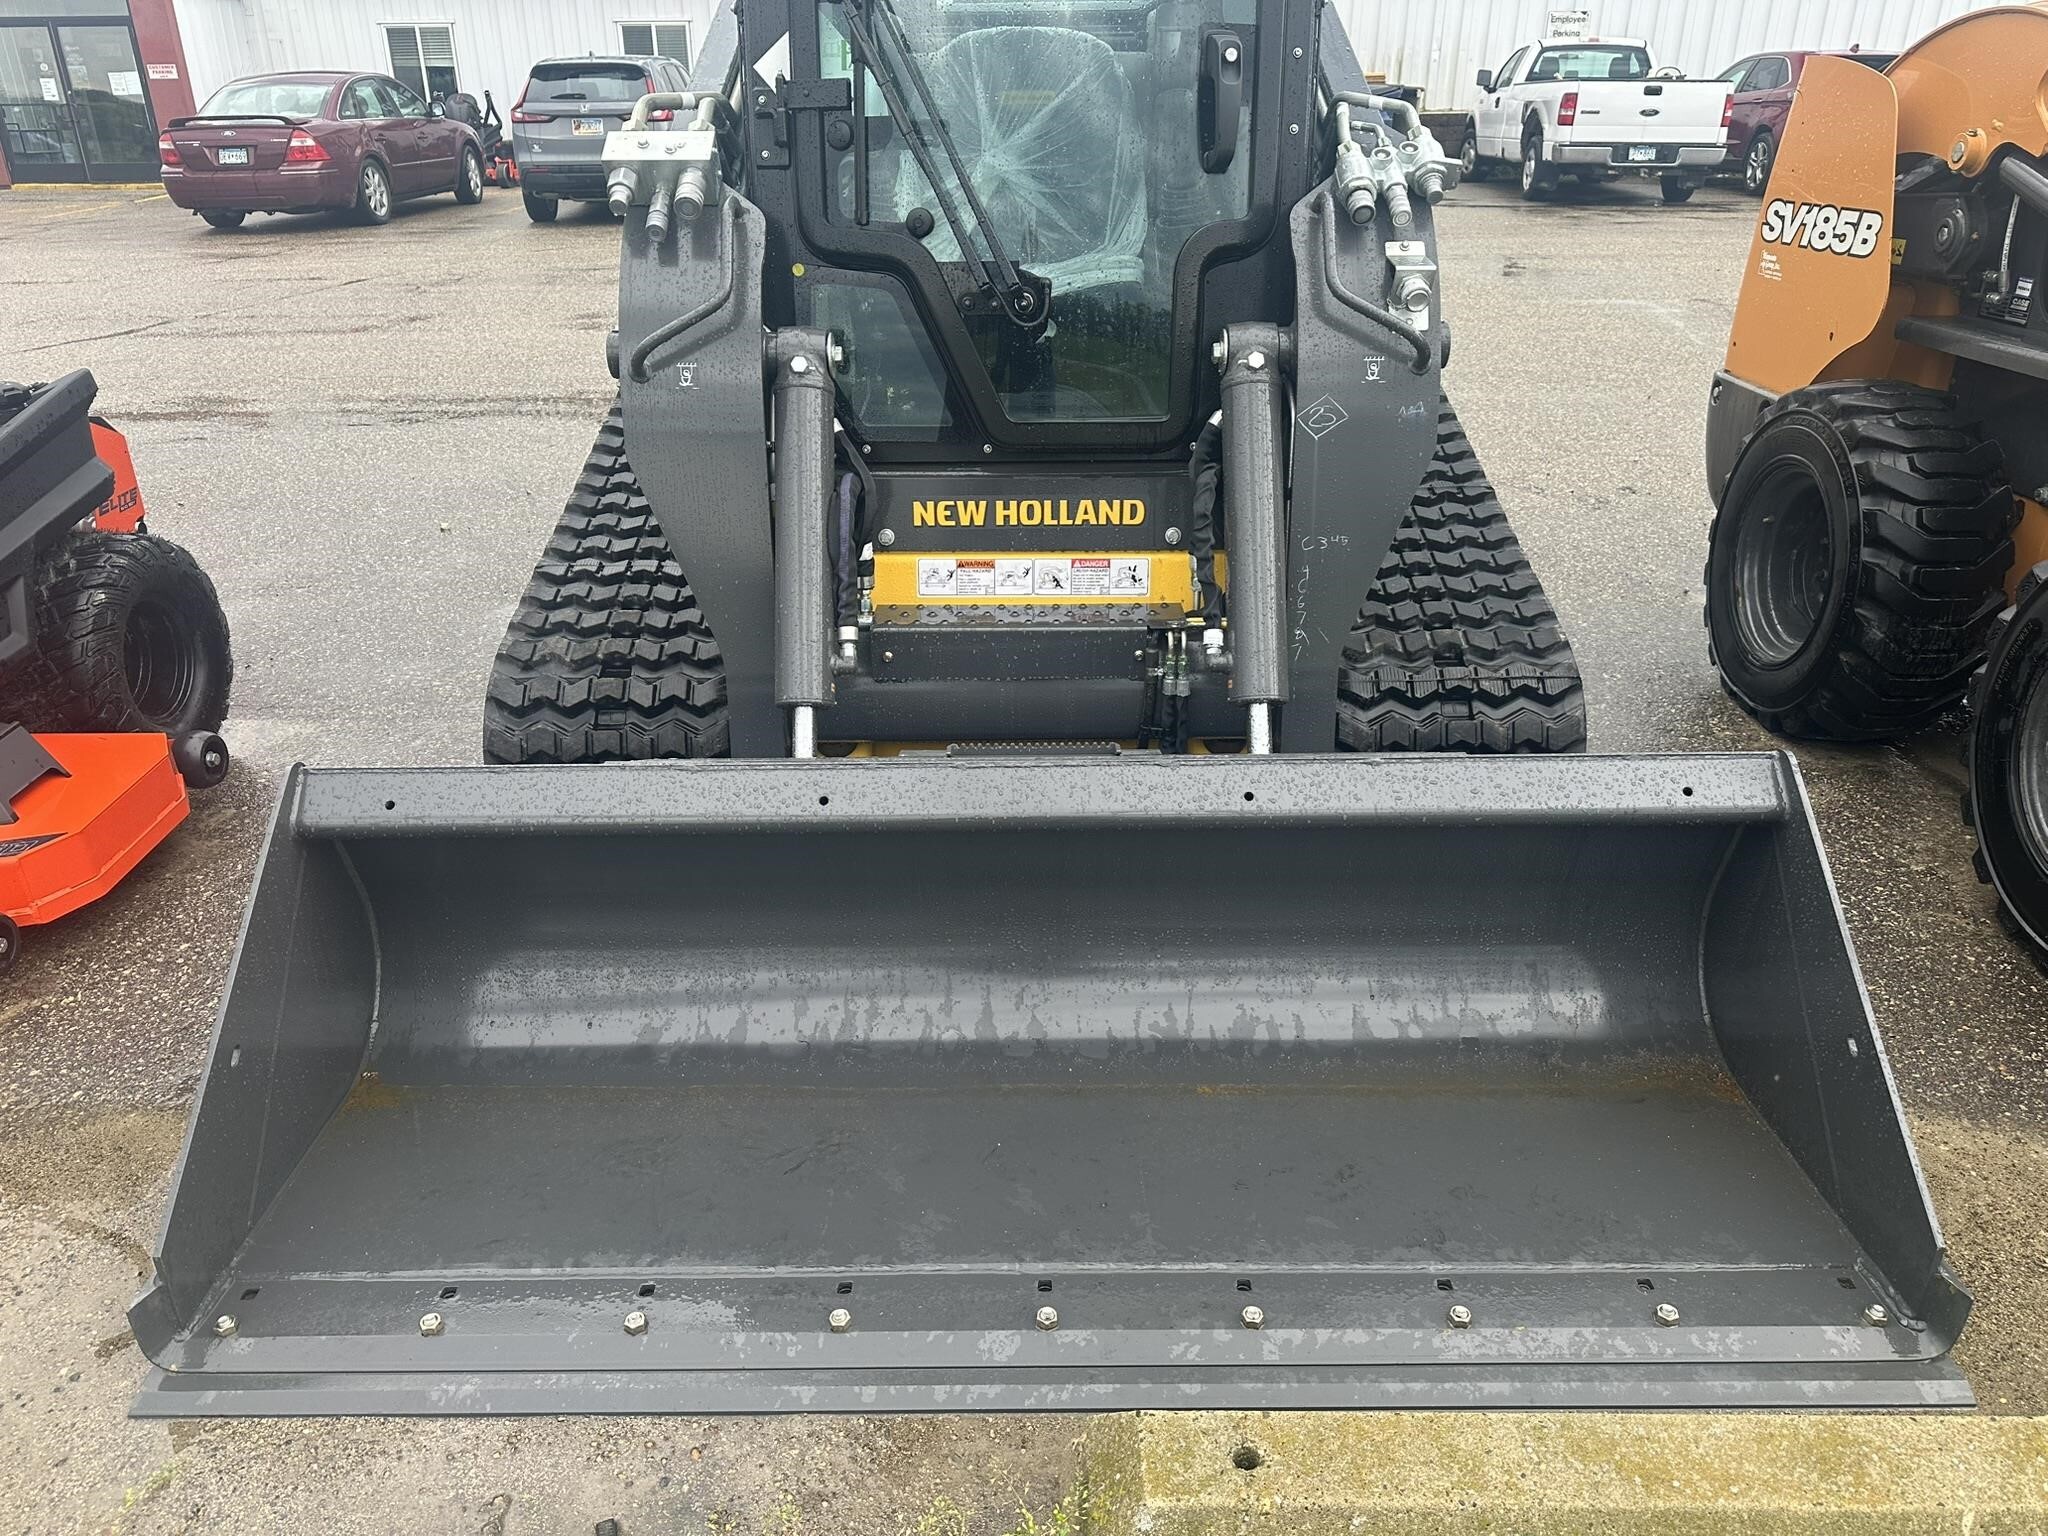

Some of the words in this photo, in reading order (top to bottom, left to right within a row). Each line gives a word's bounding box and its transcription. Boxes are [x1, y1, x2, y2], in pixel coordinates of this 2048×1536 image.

[1551, 15, 1586, 24] Employee
[1760, 198, 1883, 258] SV185B
[912, 500, 987, 526] NEW
[995, 499, 1146, 526] HOLLAND
[964, 560, 994, 568] WARNING
[1080, 559, 1109, 567] DANGER
